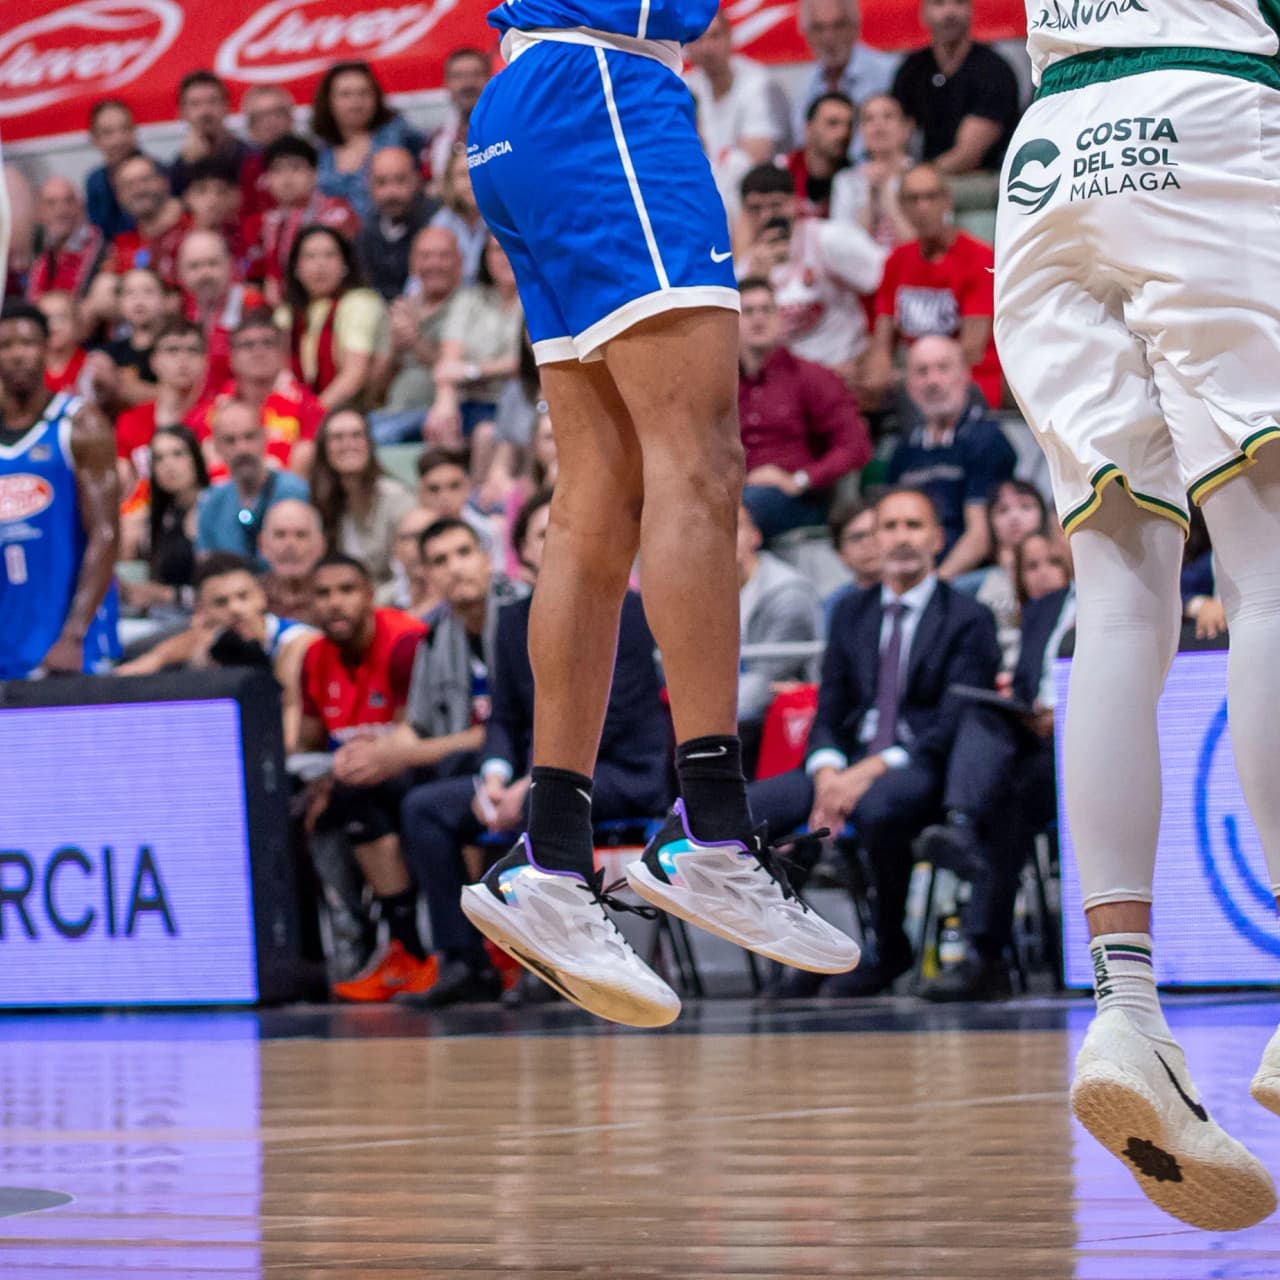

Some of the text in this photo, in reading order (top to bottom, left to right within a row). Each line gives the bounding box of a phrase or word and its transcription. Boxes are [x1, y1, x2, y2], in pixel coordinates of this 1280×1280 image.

[239, 2, 428, 60] Juver
[1076, 118, 1179, 150] COSTA
[1073, 147, 1179, 178] DEL SOL
[1070, 172, 1181, 202] MÁLAGA
